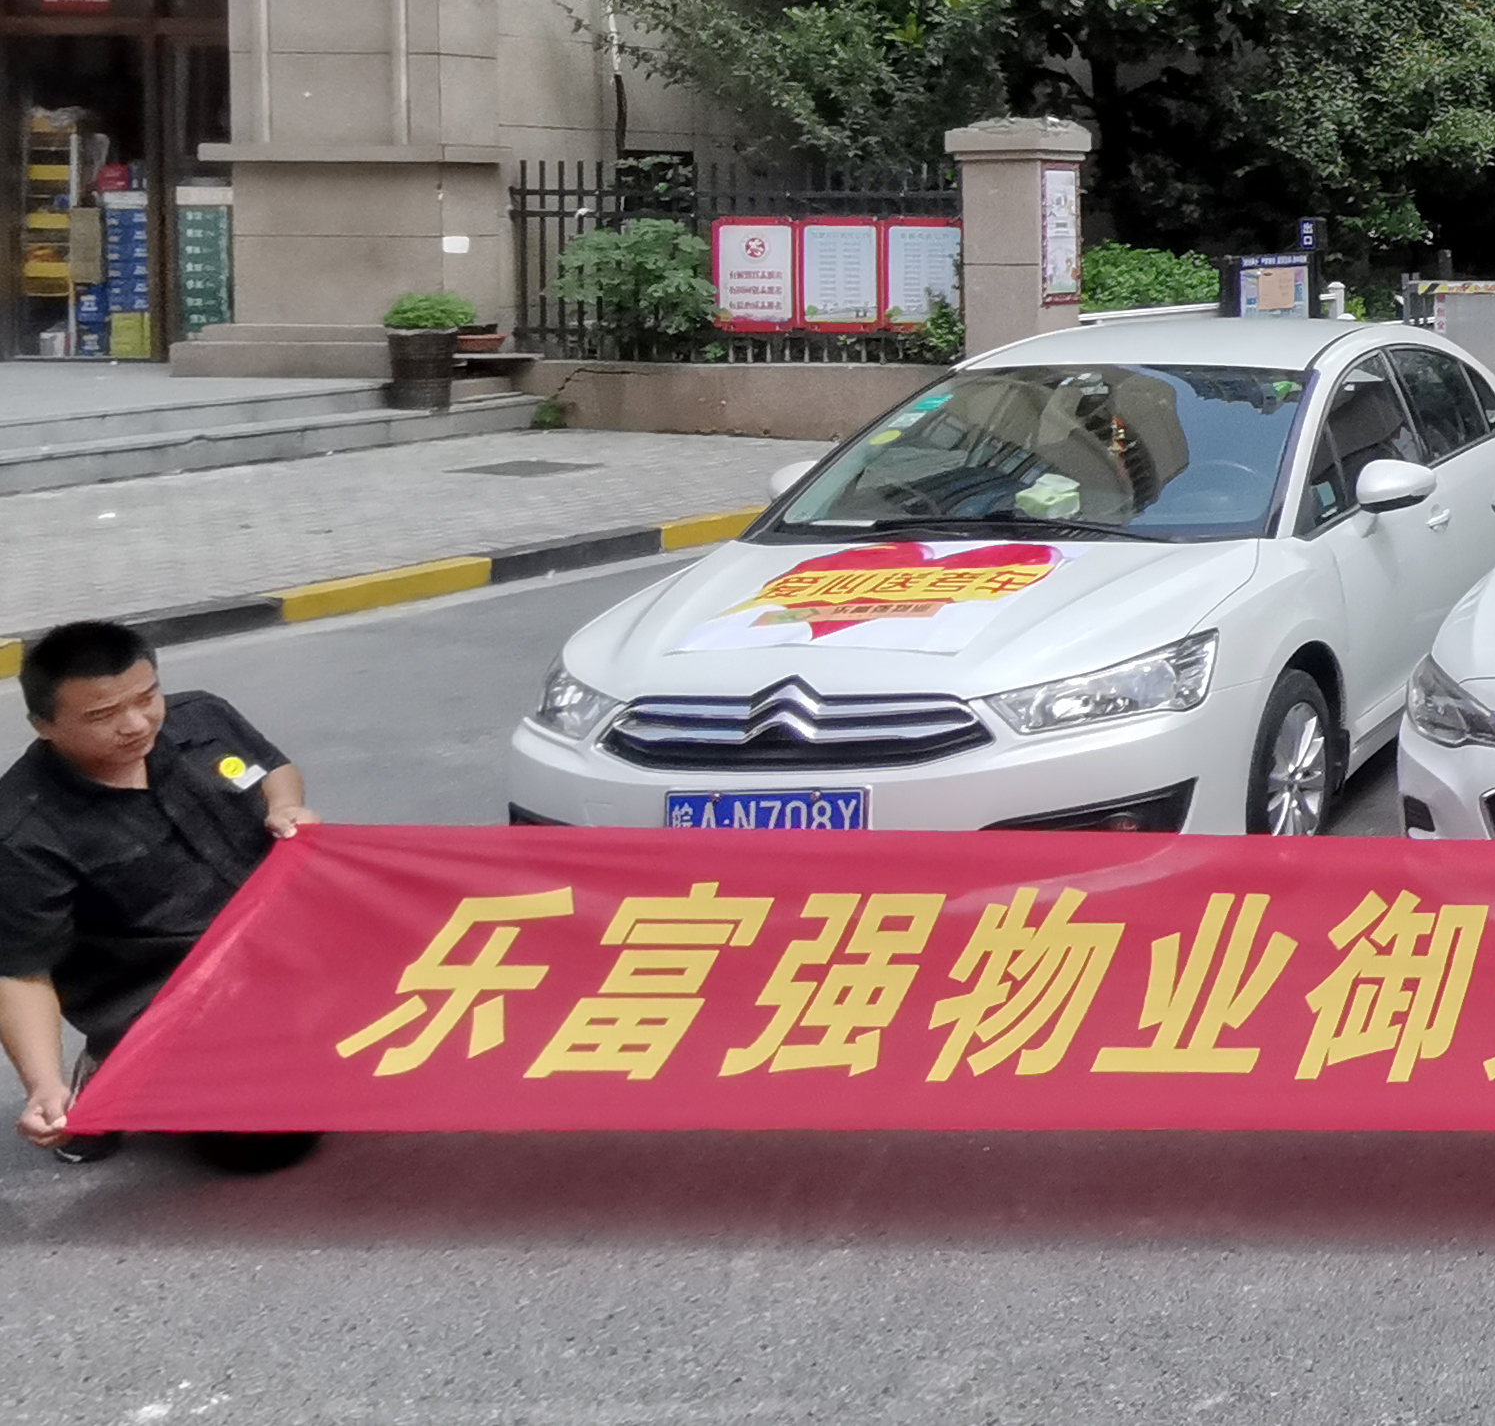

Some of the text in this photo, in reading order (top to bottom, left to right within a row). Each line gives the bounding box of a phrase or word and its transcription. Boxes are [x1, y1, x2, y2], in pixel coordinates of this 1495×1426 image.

[764, 569, 1037, 597] 爱心送考车
